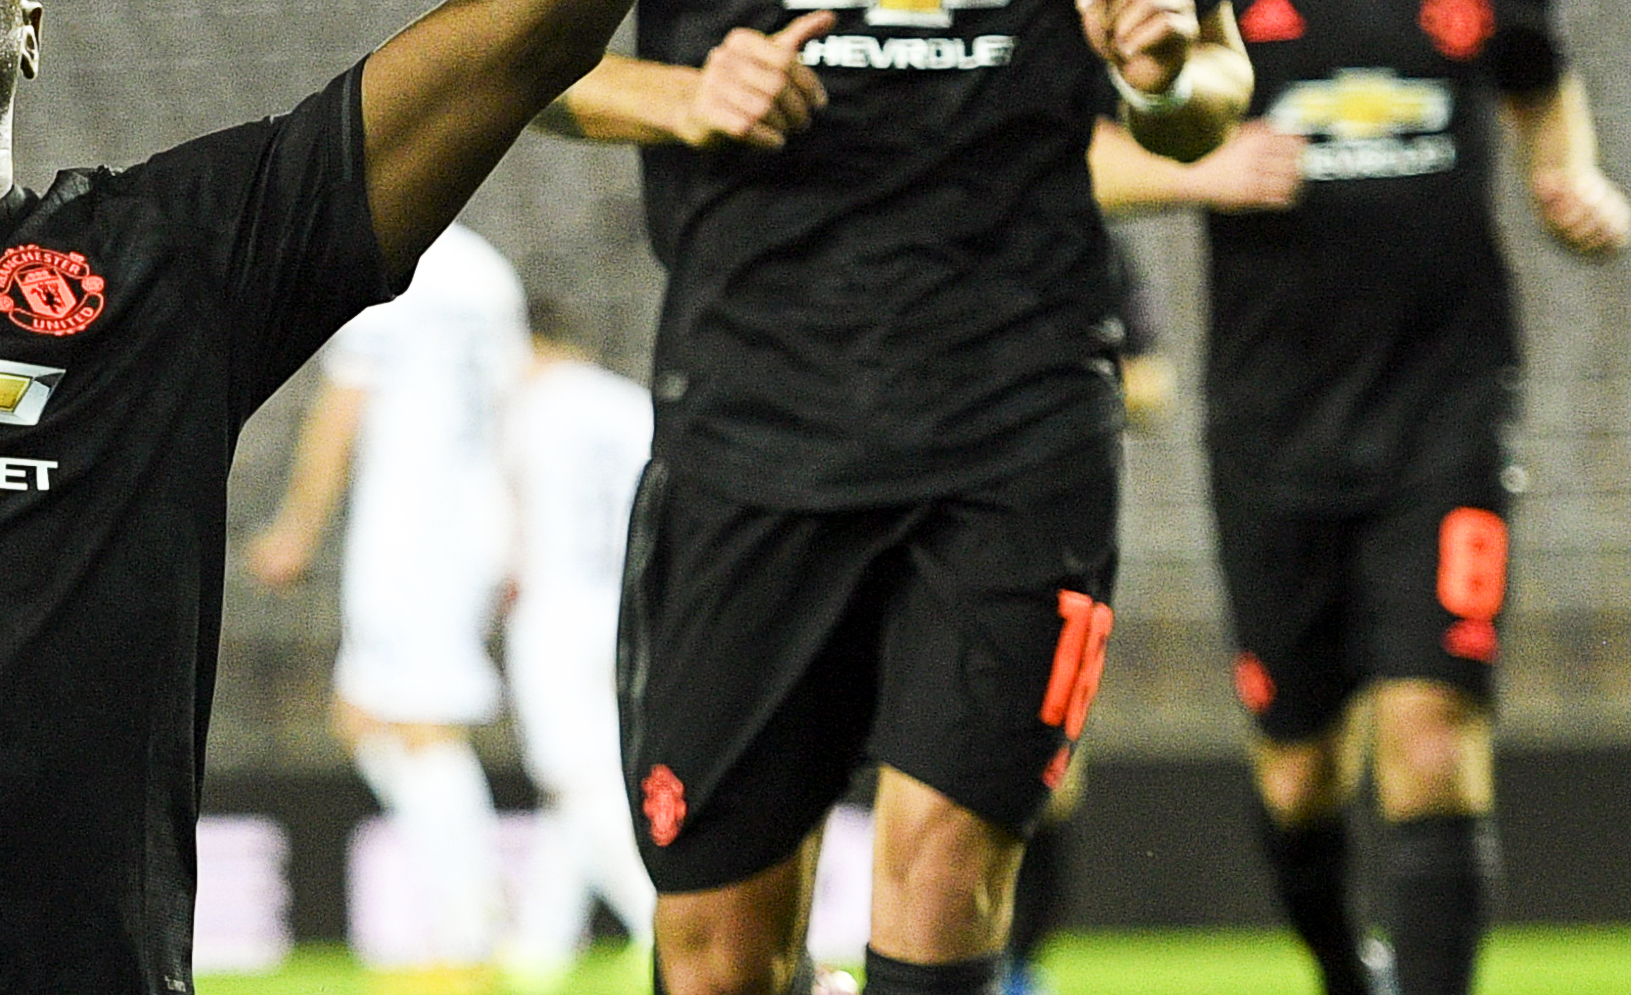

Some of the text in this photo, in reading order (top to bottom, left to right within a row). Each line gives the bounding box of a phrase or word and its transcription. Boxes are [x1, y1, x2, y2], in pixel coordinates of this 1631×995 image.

[799, 35, 1013, 70] HEVROLE
[33, 307, 95, 330] UNITED
[1437, 507, 1508, 620] 8
